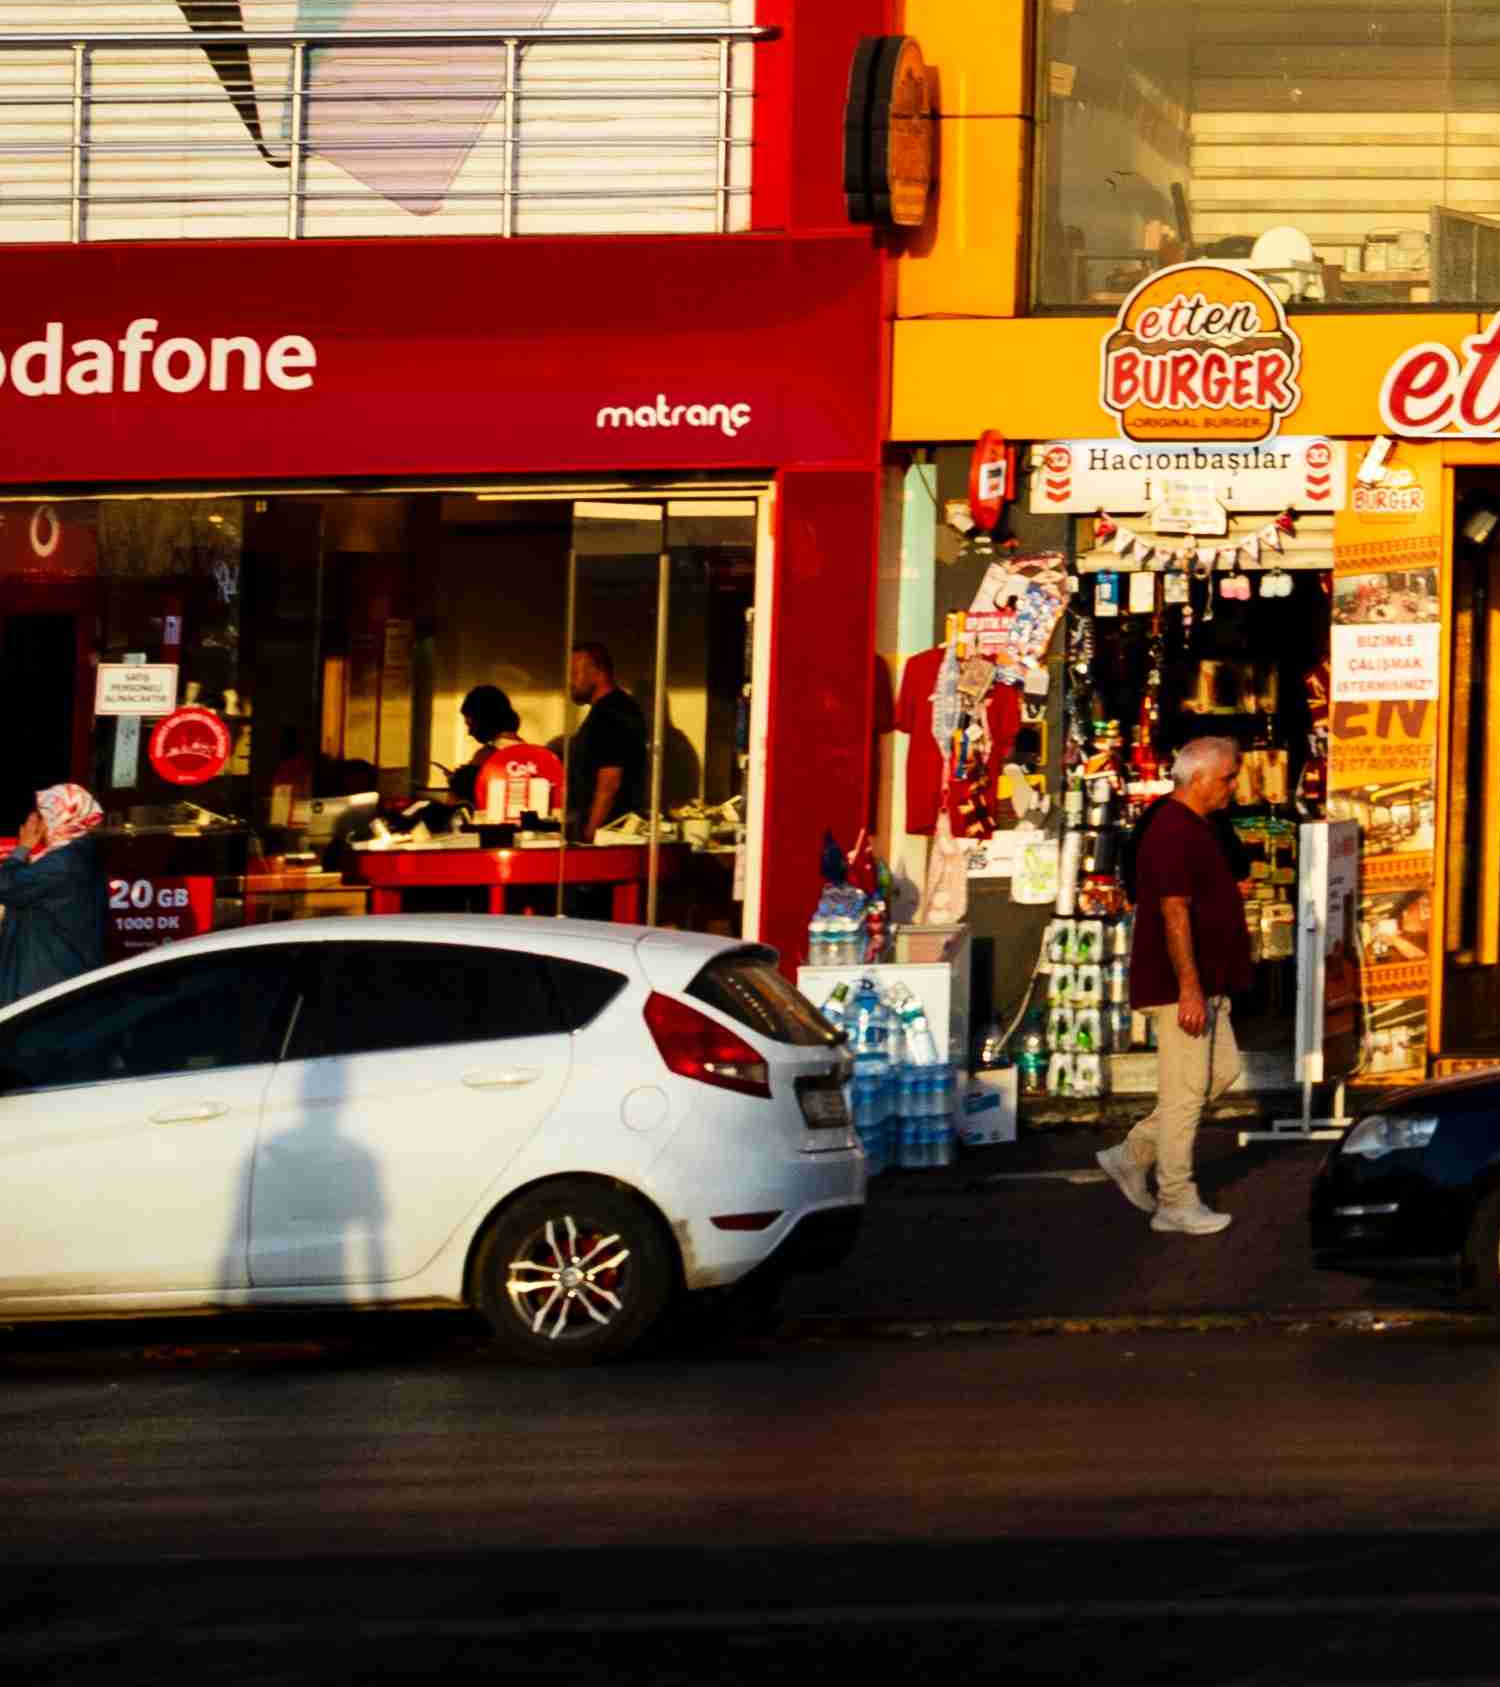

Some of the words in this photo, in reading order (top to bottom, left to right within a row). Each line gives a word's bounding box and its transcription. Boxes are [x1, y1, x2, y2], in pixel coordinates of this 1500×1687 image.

[1138, 296, 1258, 338] etten
[0, 318, 317, 397] dafone
[1111, 351, 1290, 407] BURGER
[1135, 416, 1199, 429] ORIGINAL
[1203, 416, 1260, 429] BURGER
[1088, 446, 1293, 477] Hacıonbaşılar
[1352, 489, 1423, 511] BURGER
[1333, 699, 1429, 740] EN
[108, 878, 154, 910] 20
[157, 888, 189, 908] GB
[114, 916, 155, 930] 1000
[157, 915, 180, 929] DK
